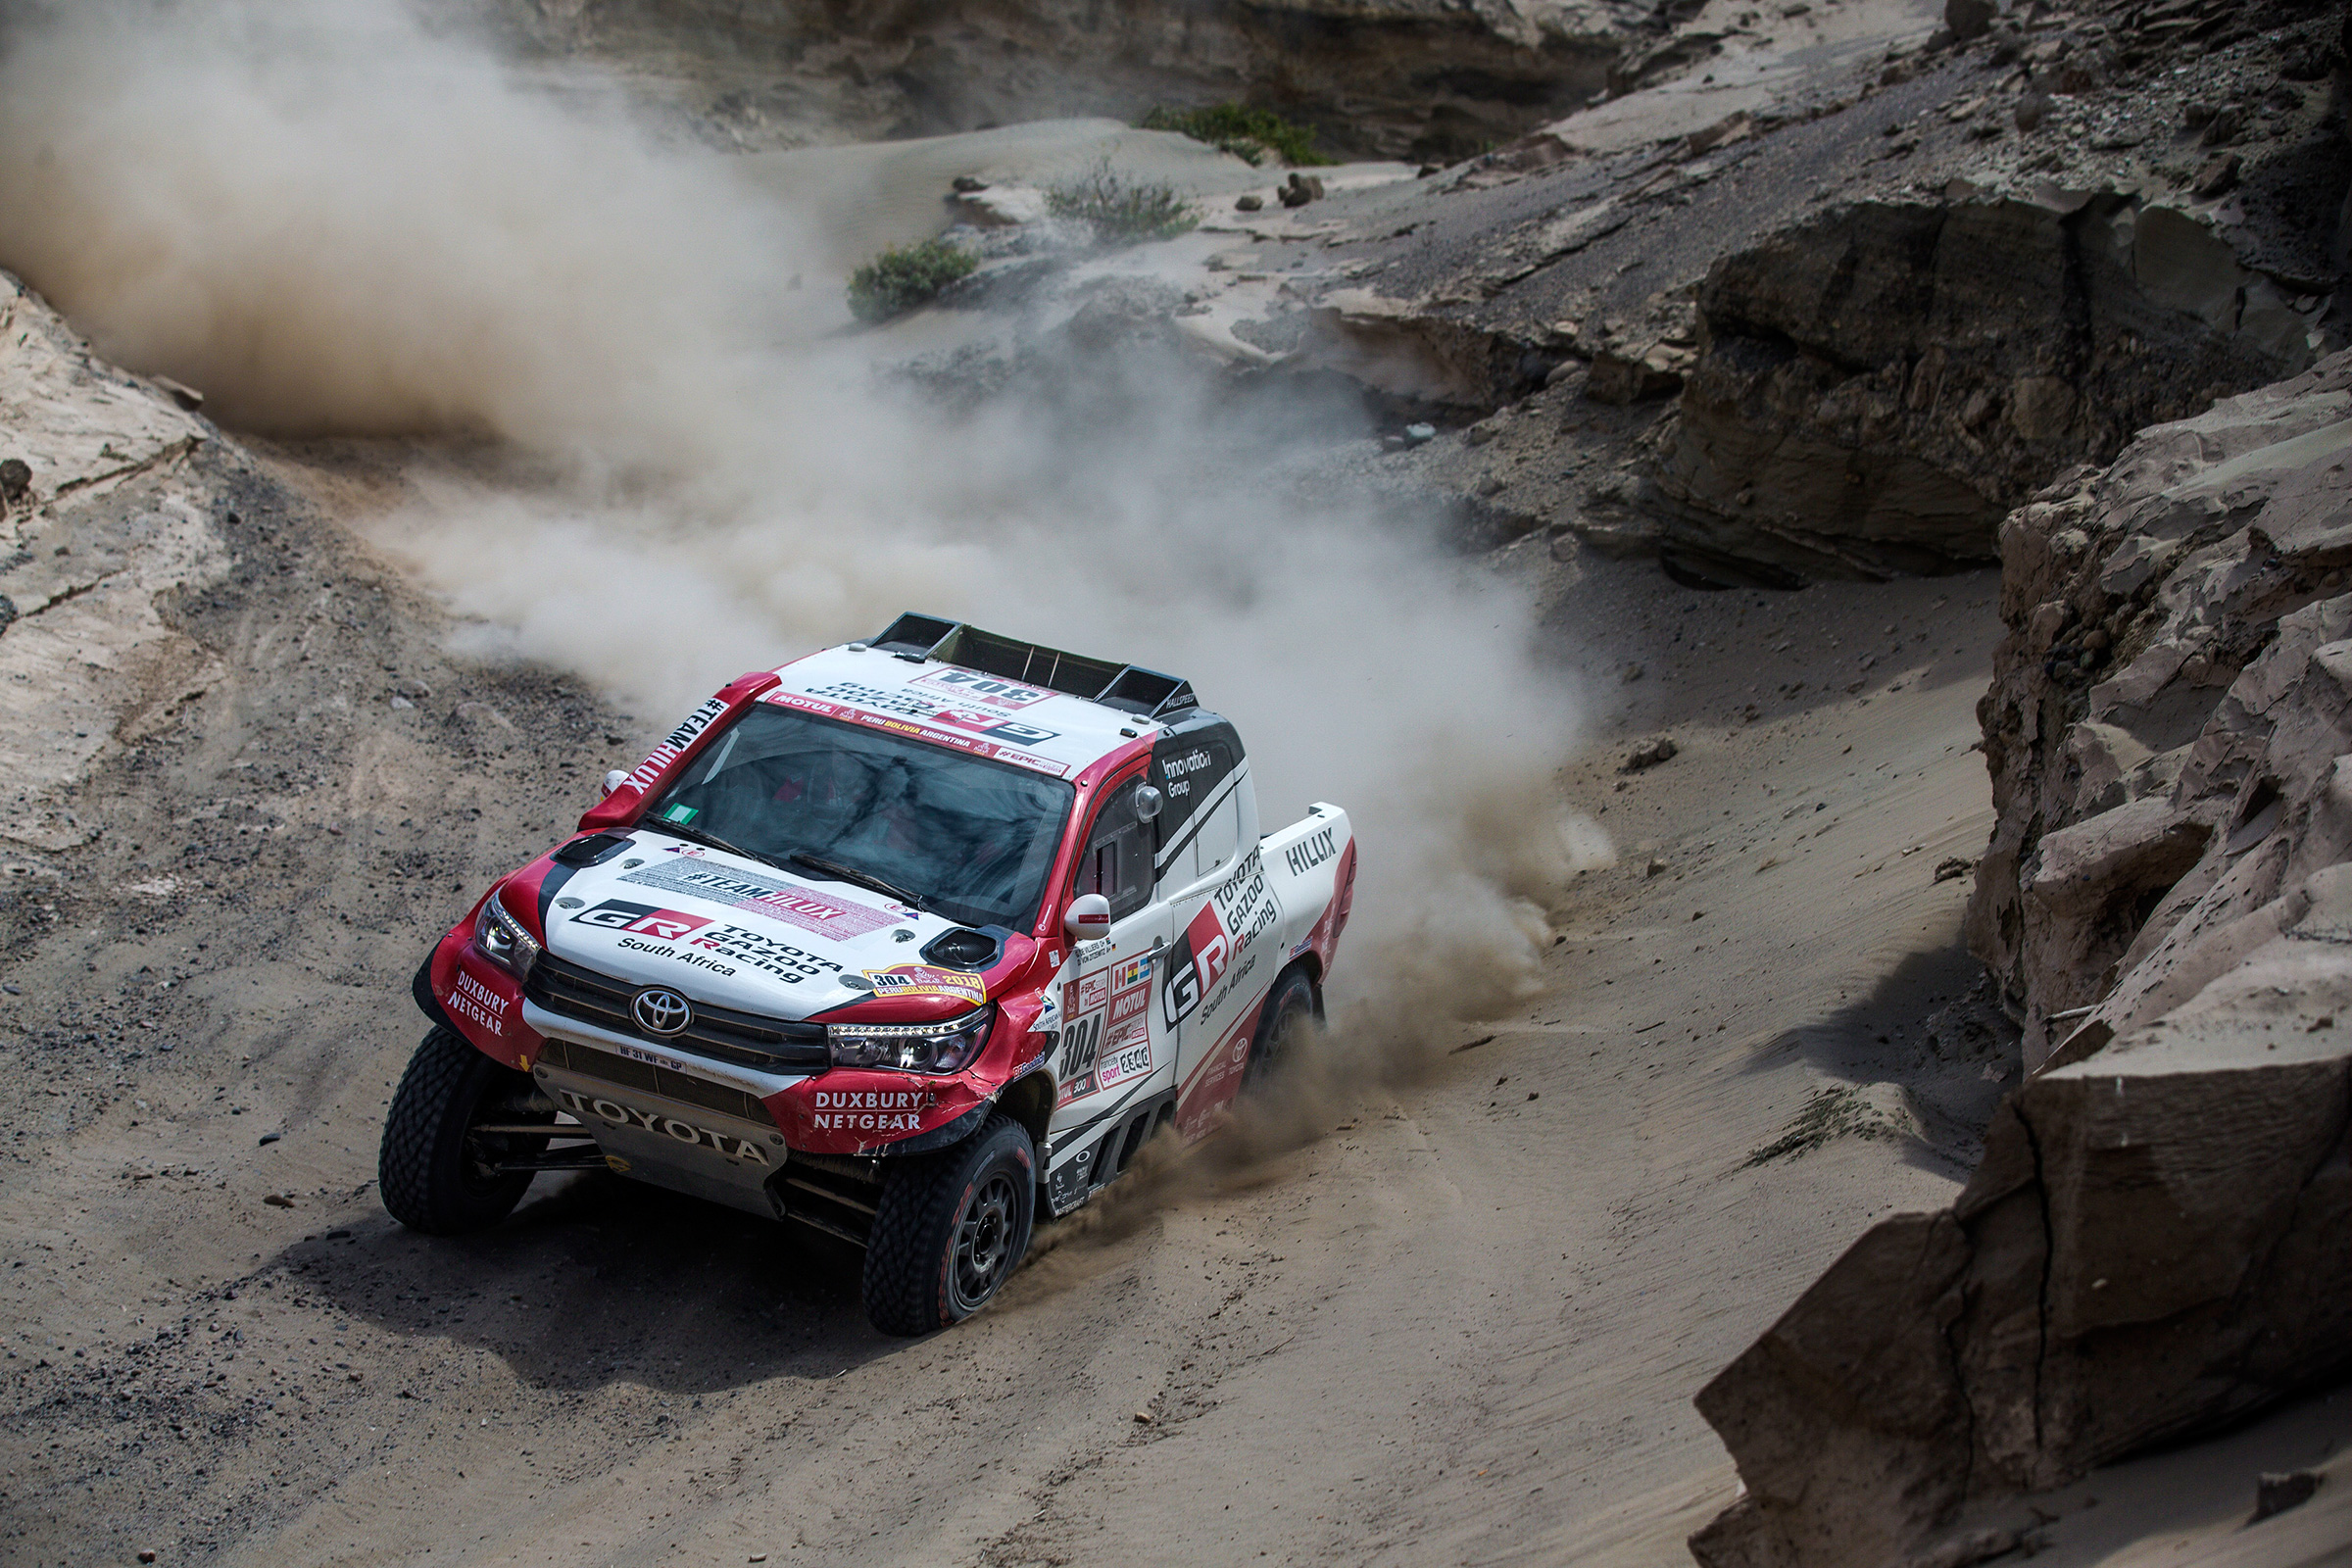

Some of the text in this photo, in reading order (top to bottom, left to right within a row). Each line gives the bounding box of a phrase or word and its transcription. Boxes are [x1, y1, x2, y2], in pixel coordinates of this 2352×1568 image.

[774, 694, 834, 713] MOTUL
[939, 670, 1040, 702] 304
[622, 699, 724, 795] #TEAMHILUX
[861, 714, 886, 725] PERU
[884, 720, 921, 734] BOLIVIA
[919, 729, 971, 748] ARGENTINA
[1167, 779, 1191, 799] Group
[1285, 826, 1337, 877] HILUX
[683, 871, 844, 921] #TEAMHILUX
[1213, 844, 1261, 910] TOYOTA
[575, 906, 696, 939] GR
[1226, 873, 1264, 936] GAZOO
[722, 923, 844, 973] TOYOTA
[1231, 898, 1277, 961] Racing
[616, 937, 737, 978] South Africa
[689, 937, 807, 985] Racing
[703, 931, 821, 977] GAZOO
[457, 970, 510, 1016] DUXBURY
[873, 974, 910, 987] 304
[877, 986, 903, 996] PERU
[938, 985, 984, 1004] ARGENTINA
[942, 975, 981, 990] 2018
[1164, 929, 1228, 1025] GR
[1200, 954, 1256, 1026] South Africa
[447, 991, 503, 1038] NETGEAR
[1112, 988, 1147, 1020] MOTUL
[632, 1049, 643, 1059] 31
[1058, 1012, 1102, 1083] 304
[1073, 1074, 1093, 1094] 300V
[1102, 1063, 1121, 1083] sport
[815, 1091, 924, 1108] DUXBURY
[558, 1087, 770, 1167] TOYOTA
[813, 1113, 921, 1130] NETGEAR
